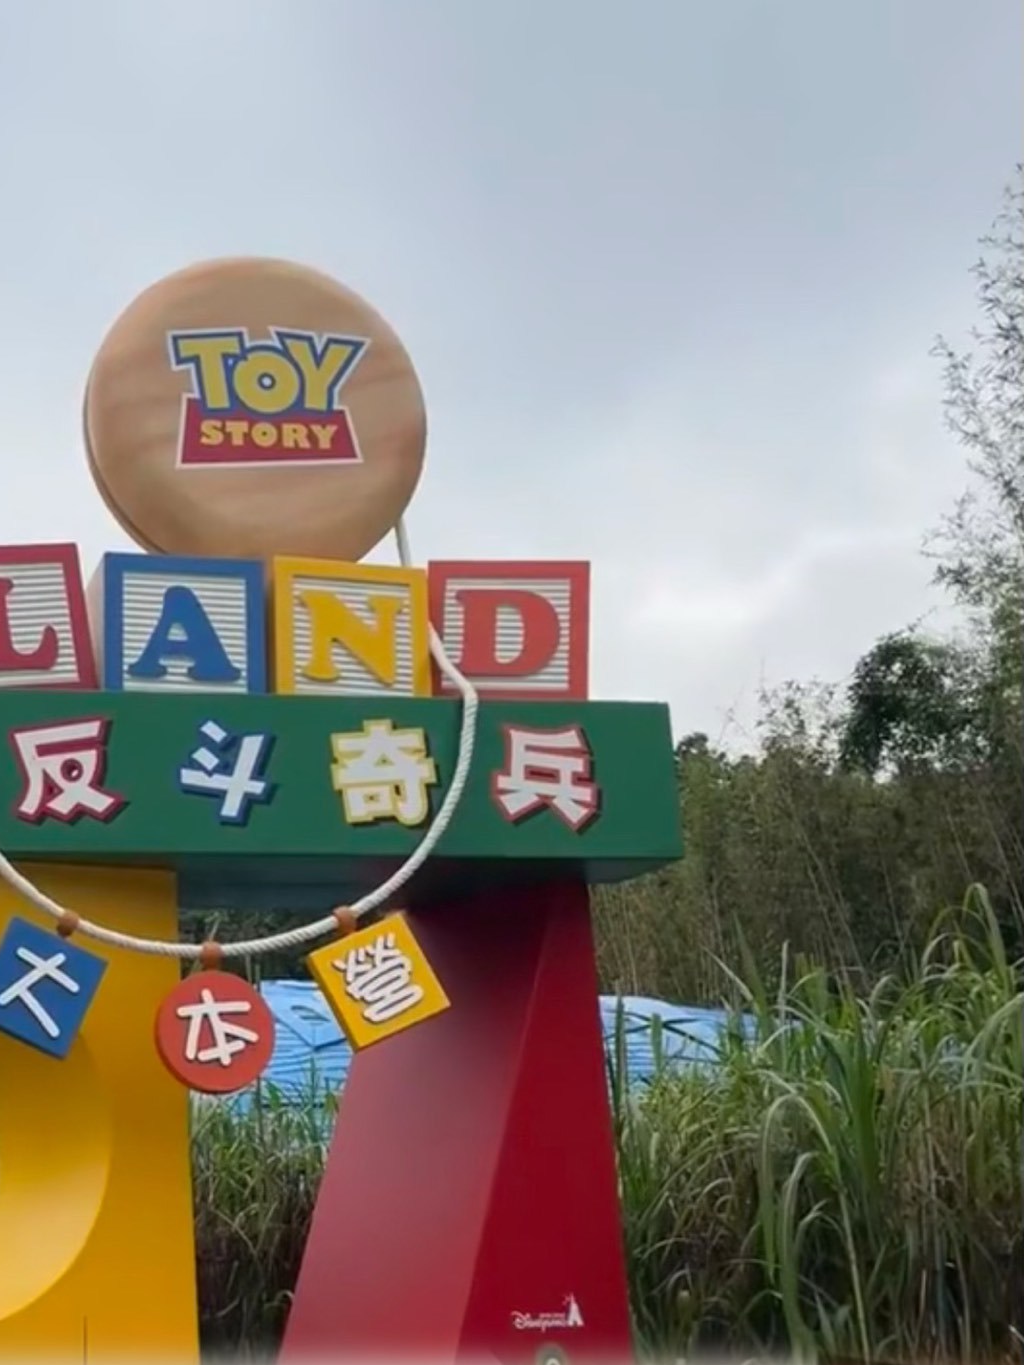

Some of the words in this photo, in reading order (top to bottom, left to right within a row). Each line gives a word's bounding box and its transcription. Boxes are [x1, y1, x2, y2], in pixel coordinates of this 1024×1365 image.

[170, 330, 367, 416] TOY
[199, 419, 338, 449] STORY
[9, 716, 600, 830] 反斗奇兵
